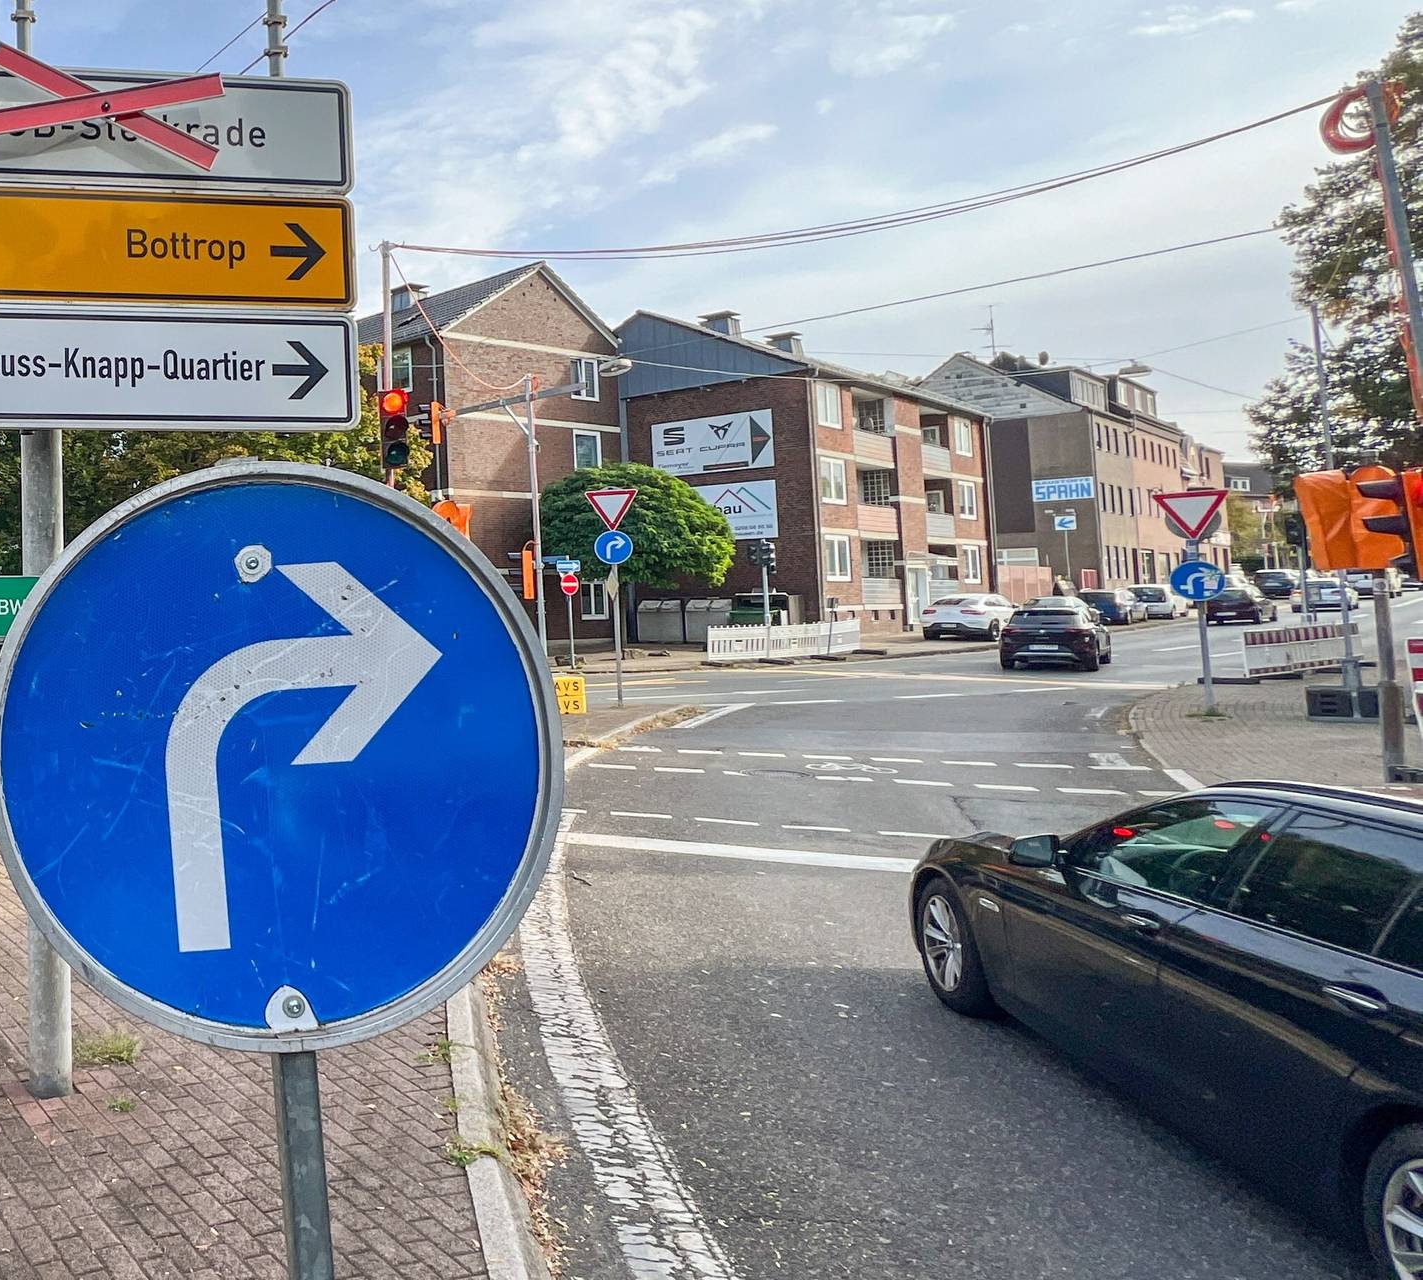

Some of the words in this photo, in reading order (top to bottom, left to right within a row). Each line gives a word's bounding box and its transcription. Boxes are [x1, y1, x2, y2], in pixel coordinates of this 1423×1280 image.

[126, 228, 246, 269] Bottrop
[656, 447, 693, 457] SEAT
[1035, 482, 1092, 500] SPAHN
[554, 681, 580, 691] AVS
[561, 700, 580, 710] VS
